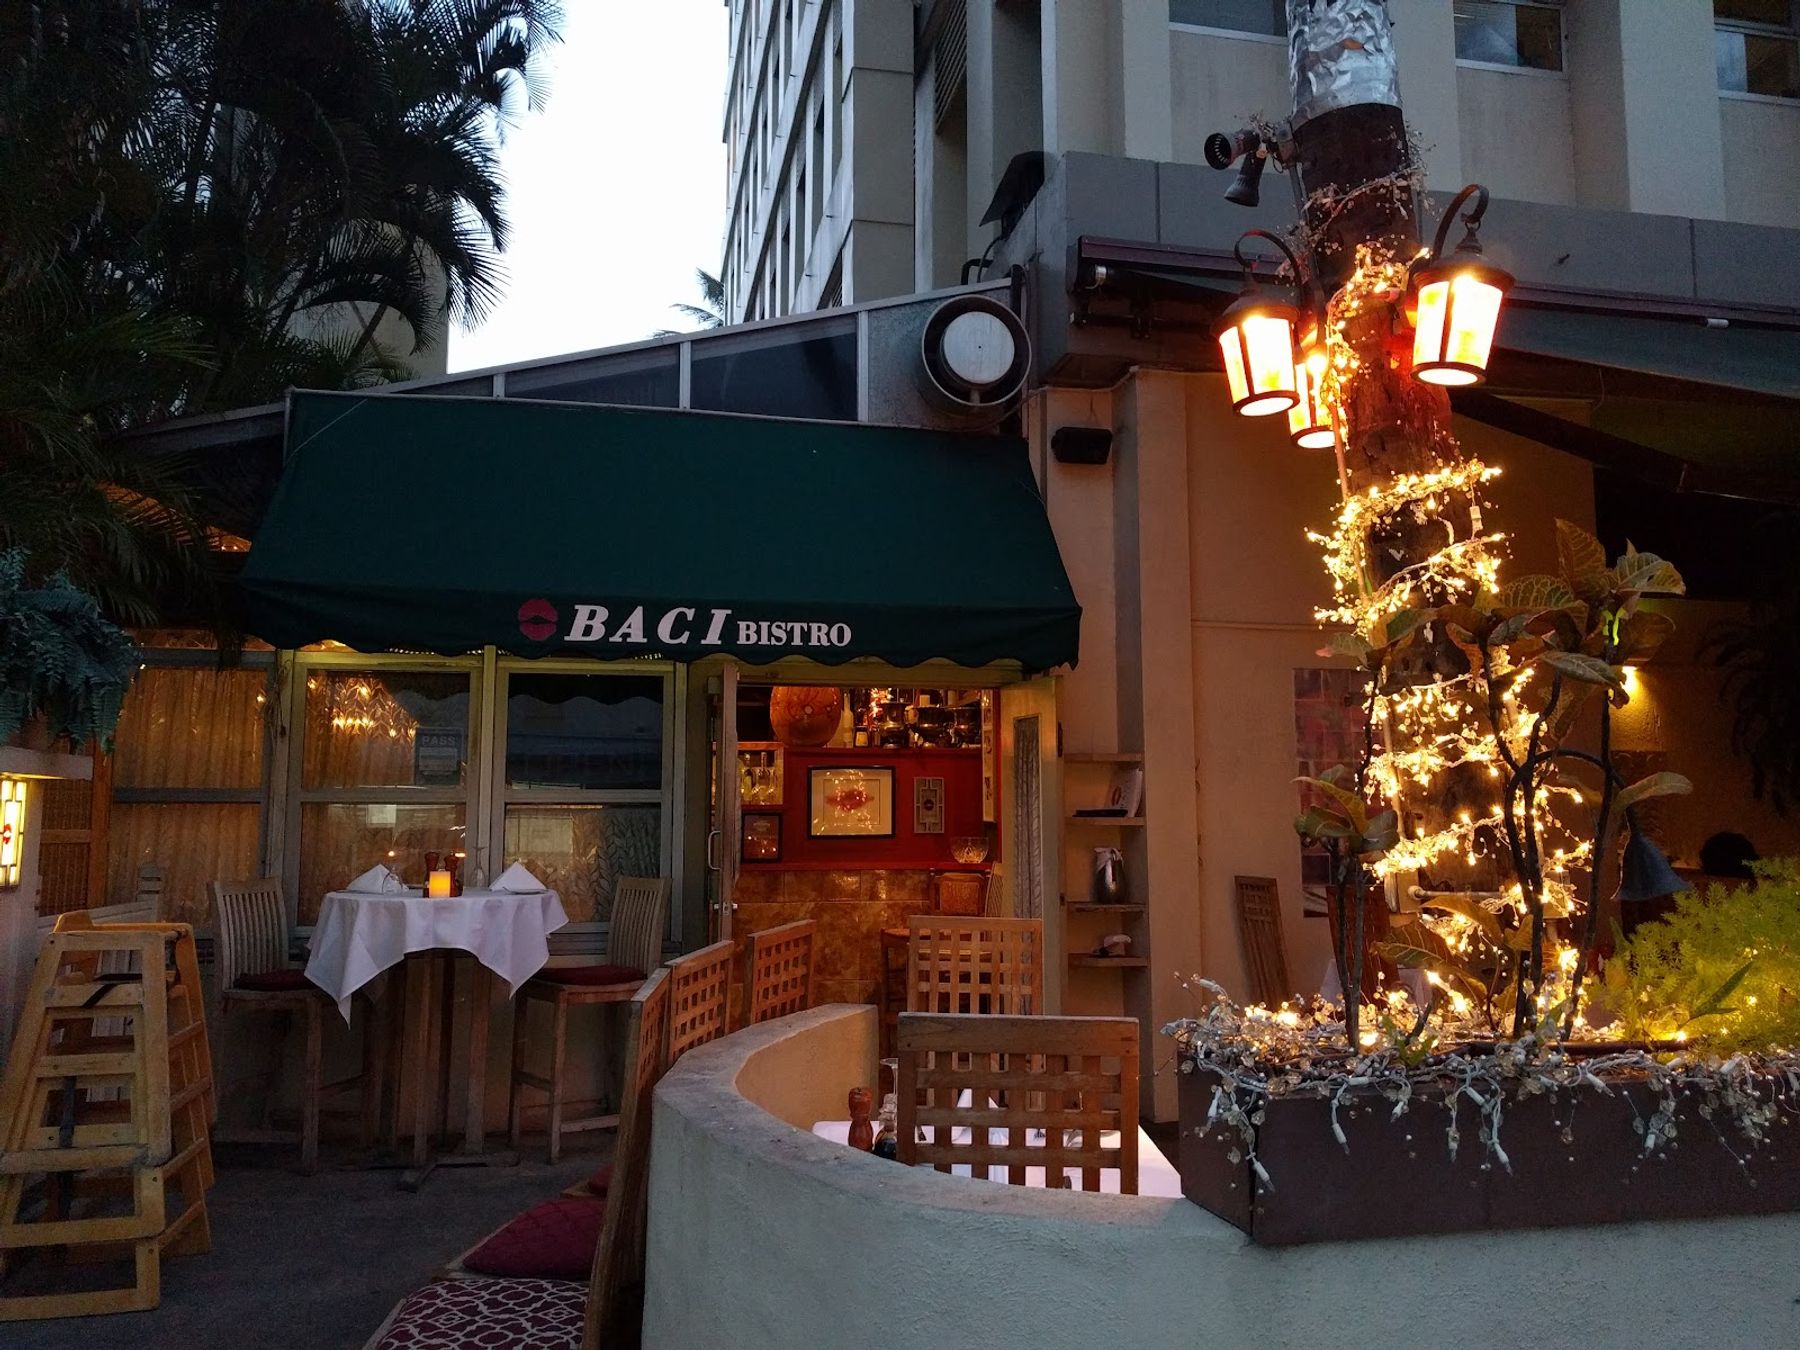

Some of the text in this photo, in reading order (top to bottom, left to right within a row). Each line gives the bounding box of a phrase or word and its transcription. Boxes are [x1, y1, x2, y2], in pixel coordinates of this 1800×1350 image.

[563, 604, 852, 647] BACI BISTRO
[421, 735, 456, 746] PASS
